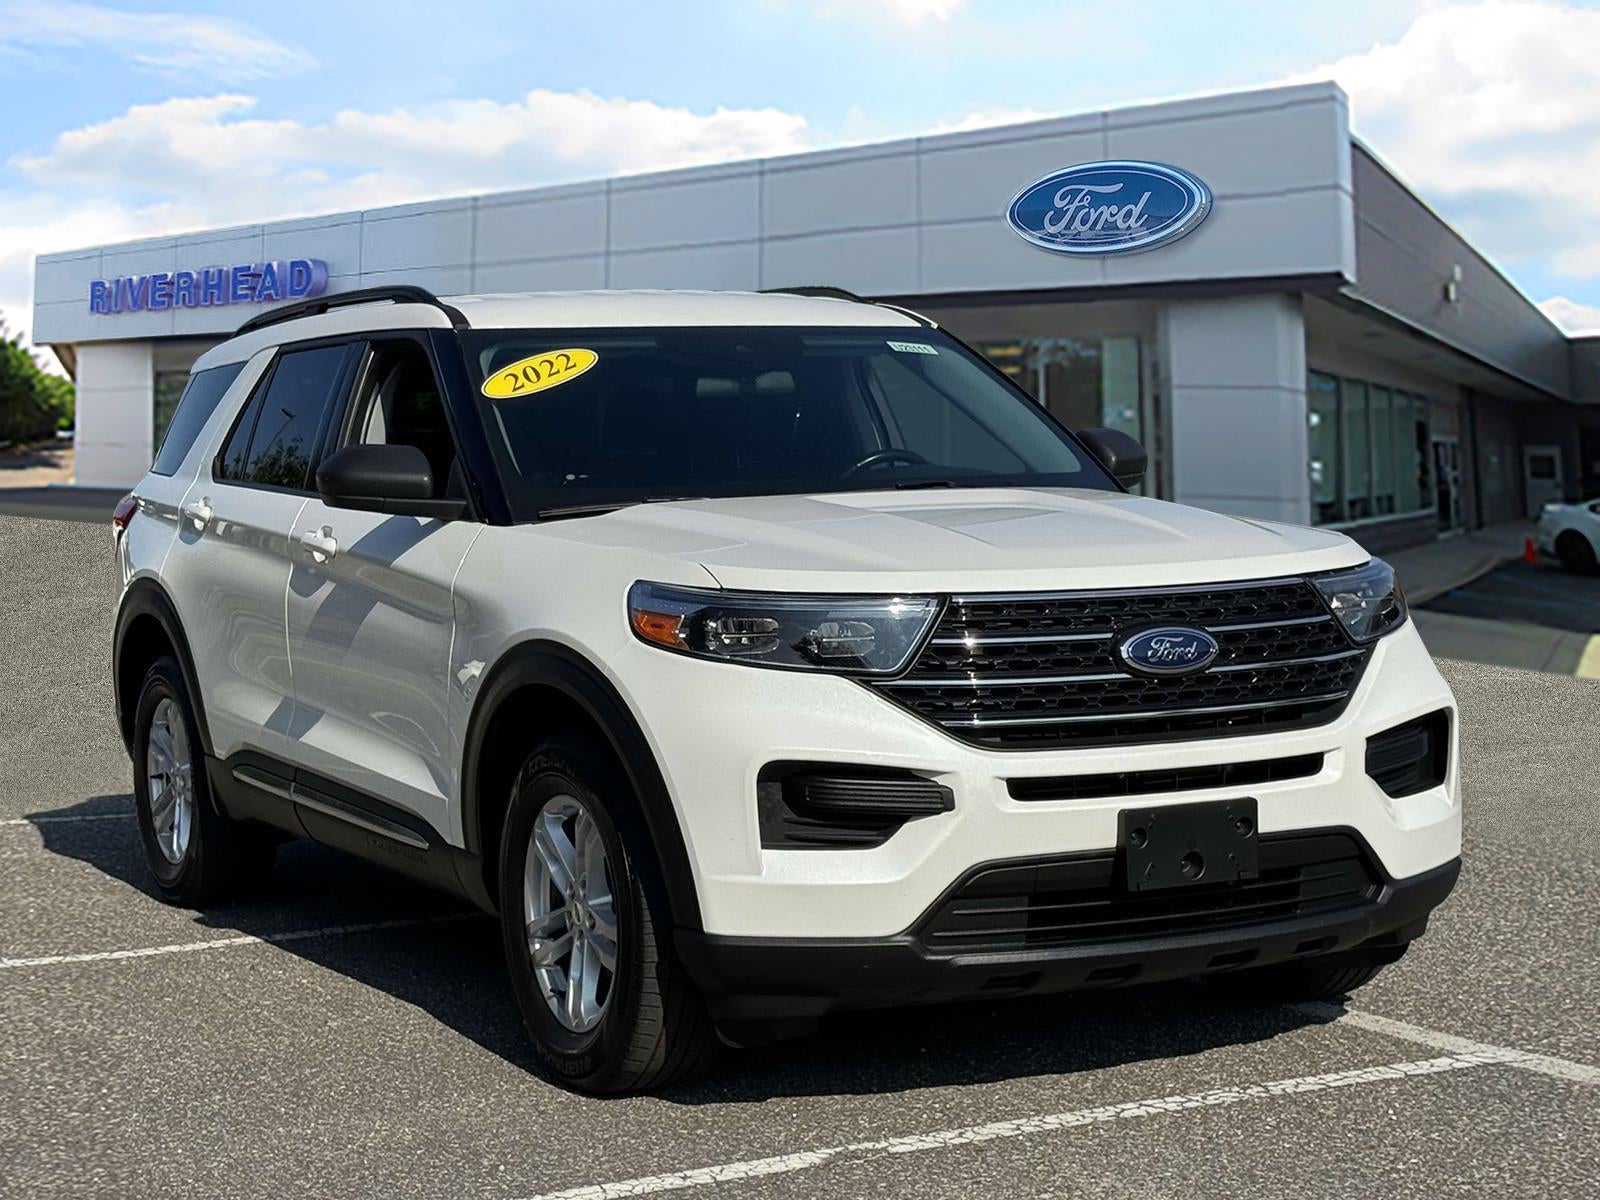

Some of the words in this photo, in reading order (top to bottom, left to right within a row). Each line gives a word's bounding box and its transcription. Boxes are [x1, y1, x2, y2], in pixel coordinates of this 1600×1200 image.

[1044, 183, 1152, 233] Ford
[90, 259, 324, 315] RIVERHEAD
[503, 353, 577, 393] 2022
[1147, 636, 1198, 662] Ford
